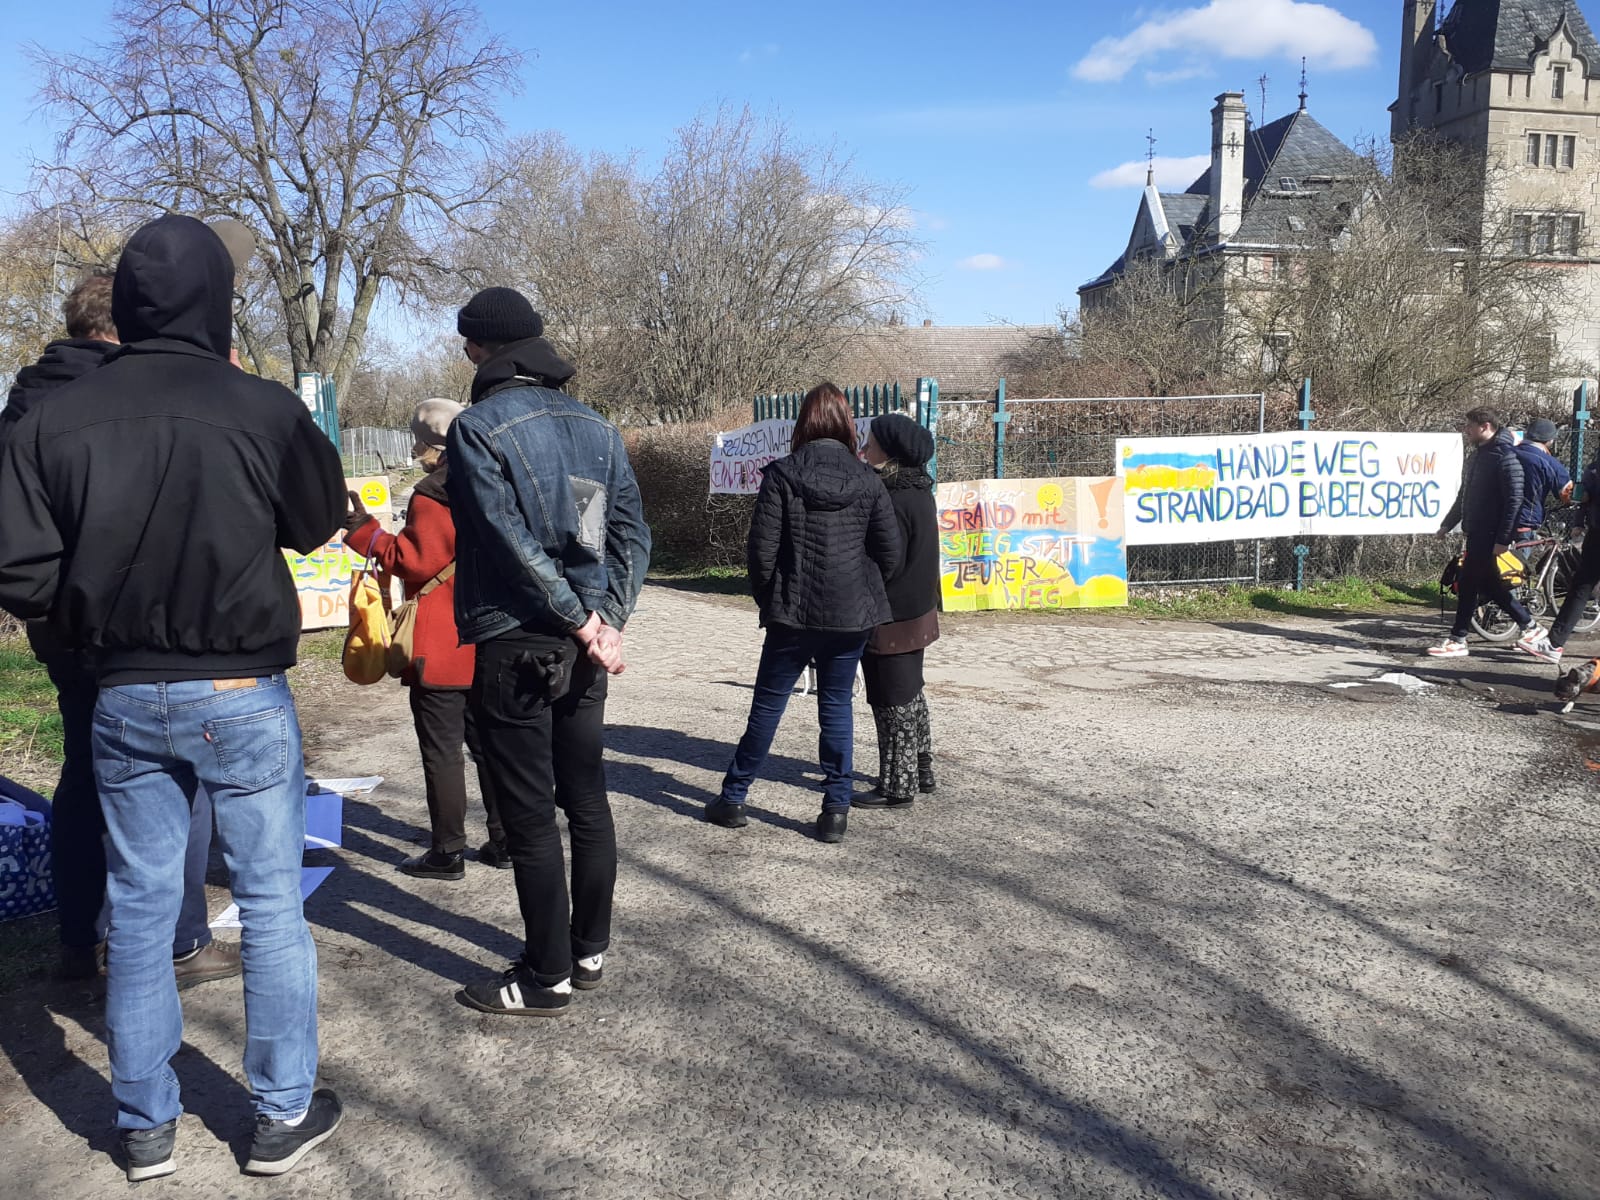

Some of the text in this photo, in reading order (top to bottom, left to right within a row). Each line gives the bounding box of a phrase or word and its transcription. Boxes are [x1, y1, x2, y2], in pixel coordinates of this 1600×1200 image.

[1216, 440, 1436, 482] HÄNDE WEG VOM
[938, 500, 1067, 531] STRAND mit
[1136, 480, 1441, 524] STRANDBAD BABELSBERG
[941, 531, 1012, 558] STEG
[948, 556, 1041, 590] TEURER
[1003, 584, 1063, 609] WEG
